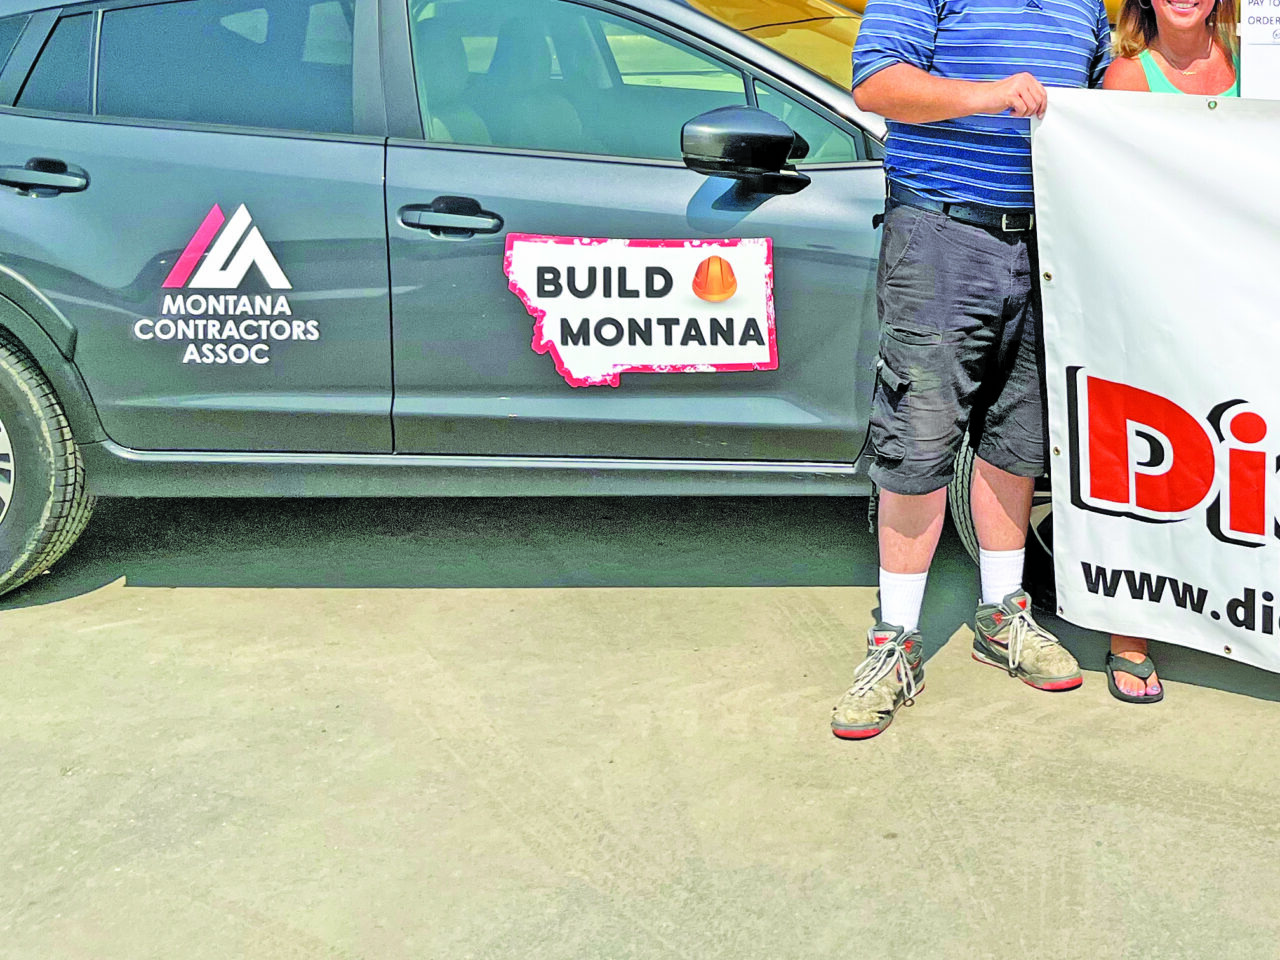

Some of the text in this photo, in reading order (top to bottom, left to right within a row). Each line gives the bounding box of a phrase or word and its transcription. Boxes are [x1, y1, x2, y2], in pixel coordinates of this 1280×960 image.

[1247, 16, 1280, 25] ORDER
[536, 265, 674, 299] BUILD
[162, 294, 292, 315] MONTANA
[134, 318, 320, 340] CONTRACTORS
[560, 316, 765, 347] MONTANA
[182, 343, 270, 364] ASSOC
